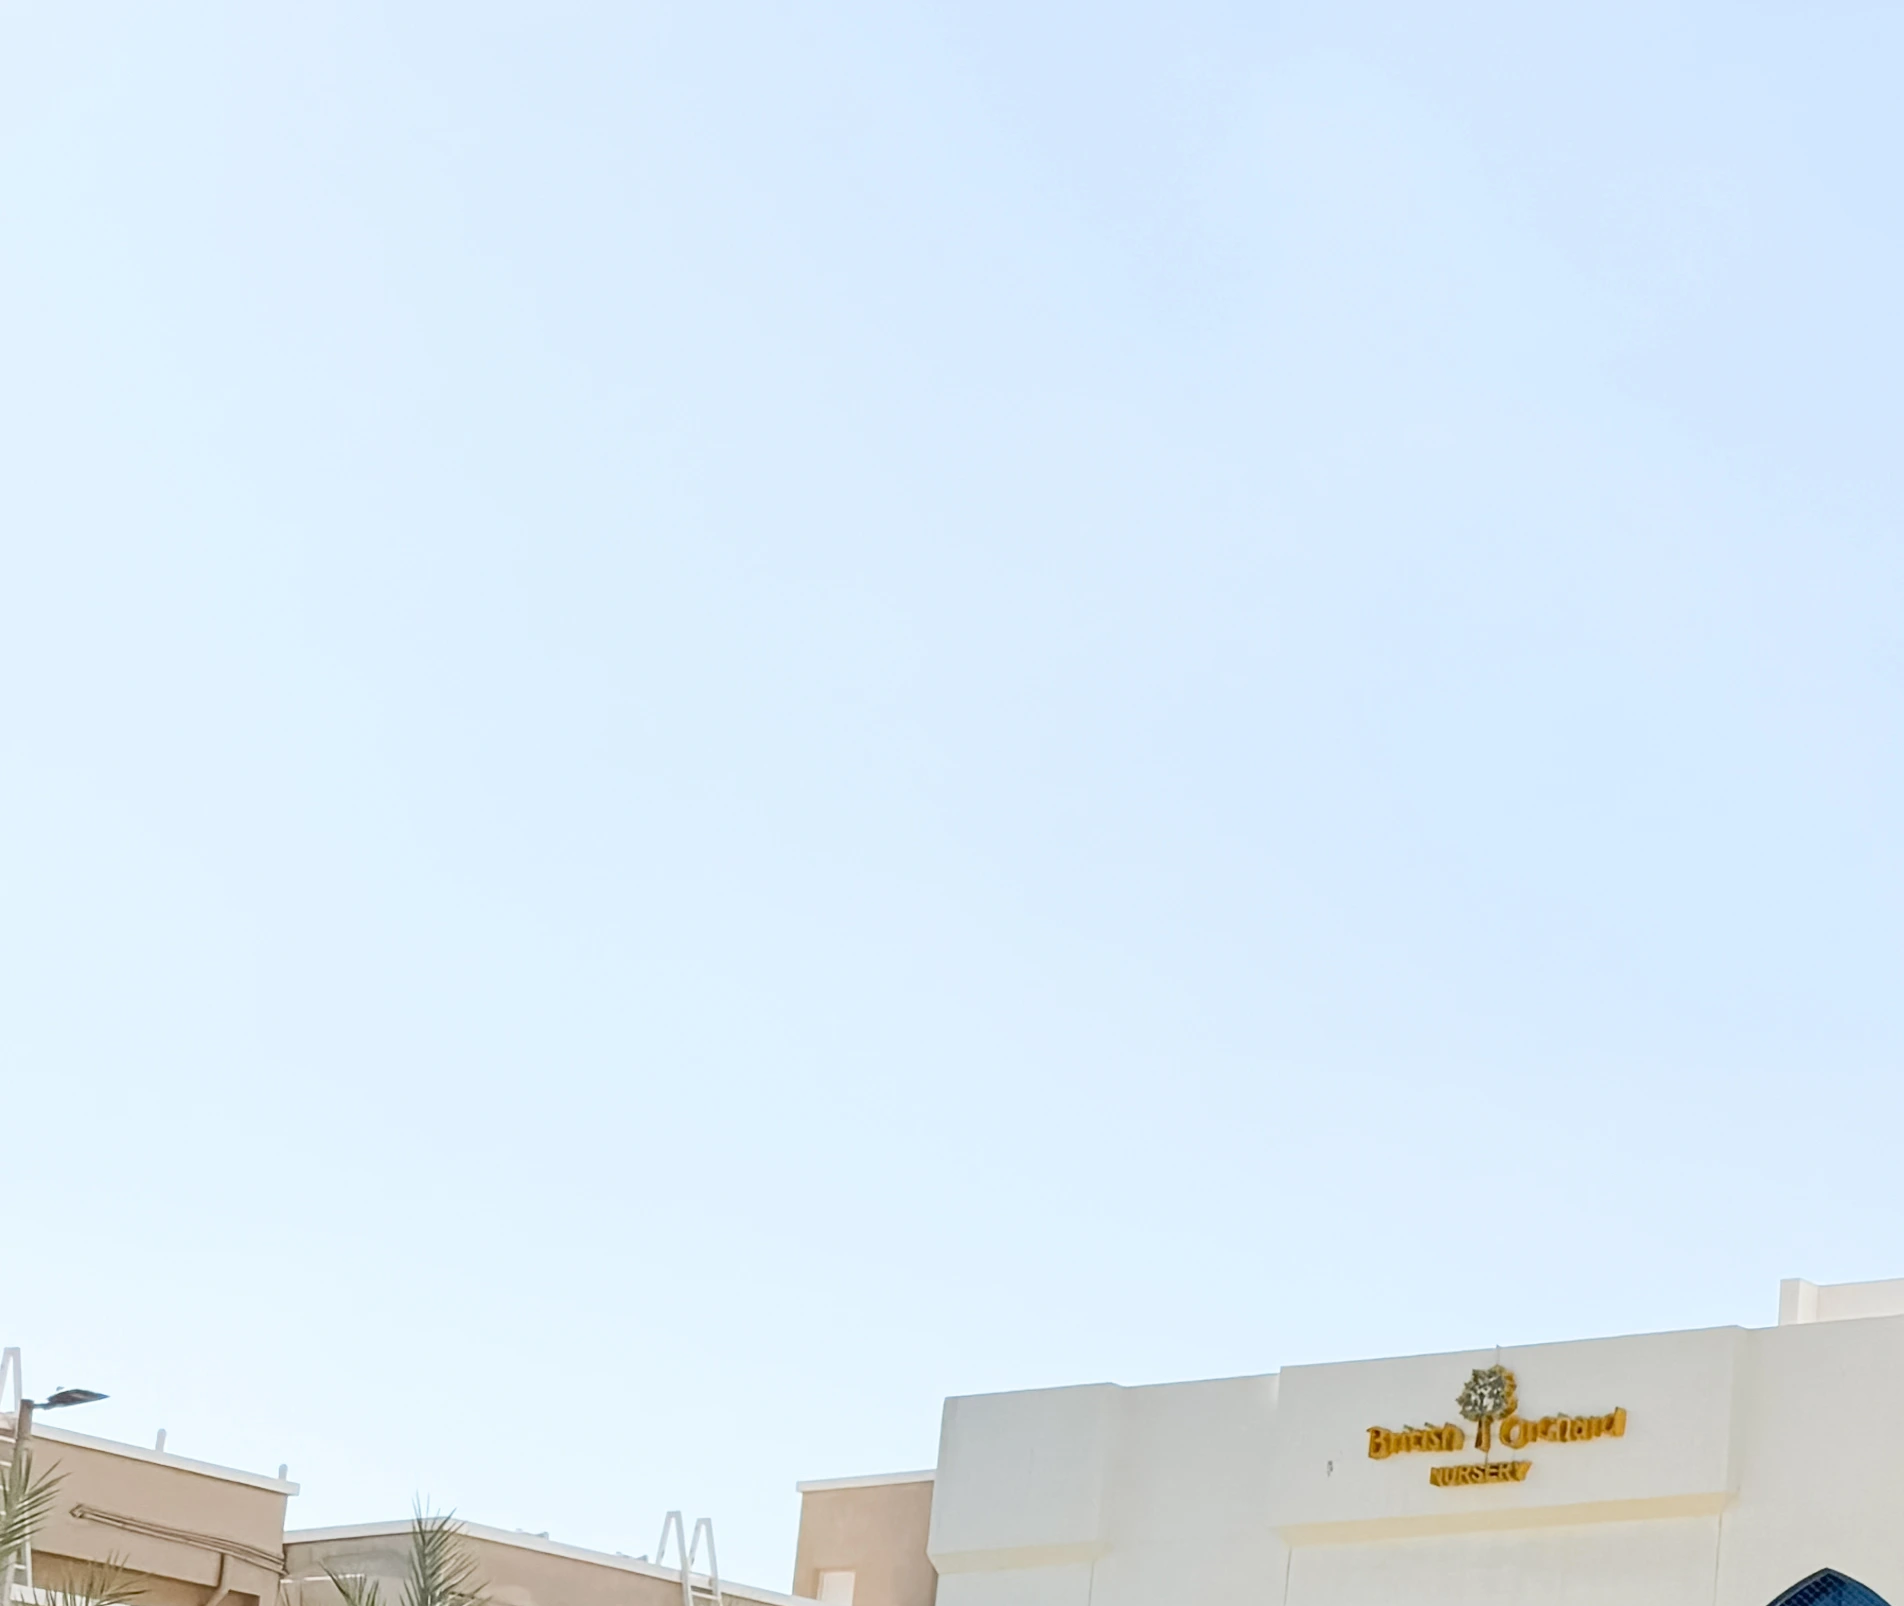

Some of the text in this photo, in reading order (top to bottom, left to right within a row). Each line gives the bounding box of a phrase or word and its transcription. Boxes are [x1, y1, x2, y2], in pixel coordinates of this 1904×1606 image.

[1366, 1406, 1627, 1460] British Orchard
[1429, 1460, 1533, 1487] NURSERY
